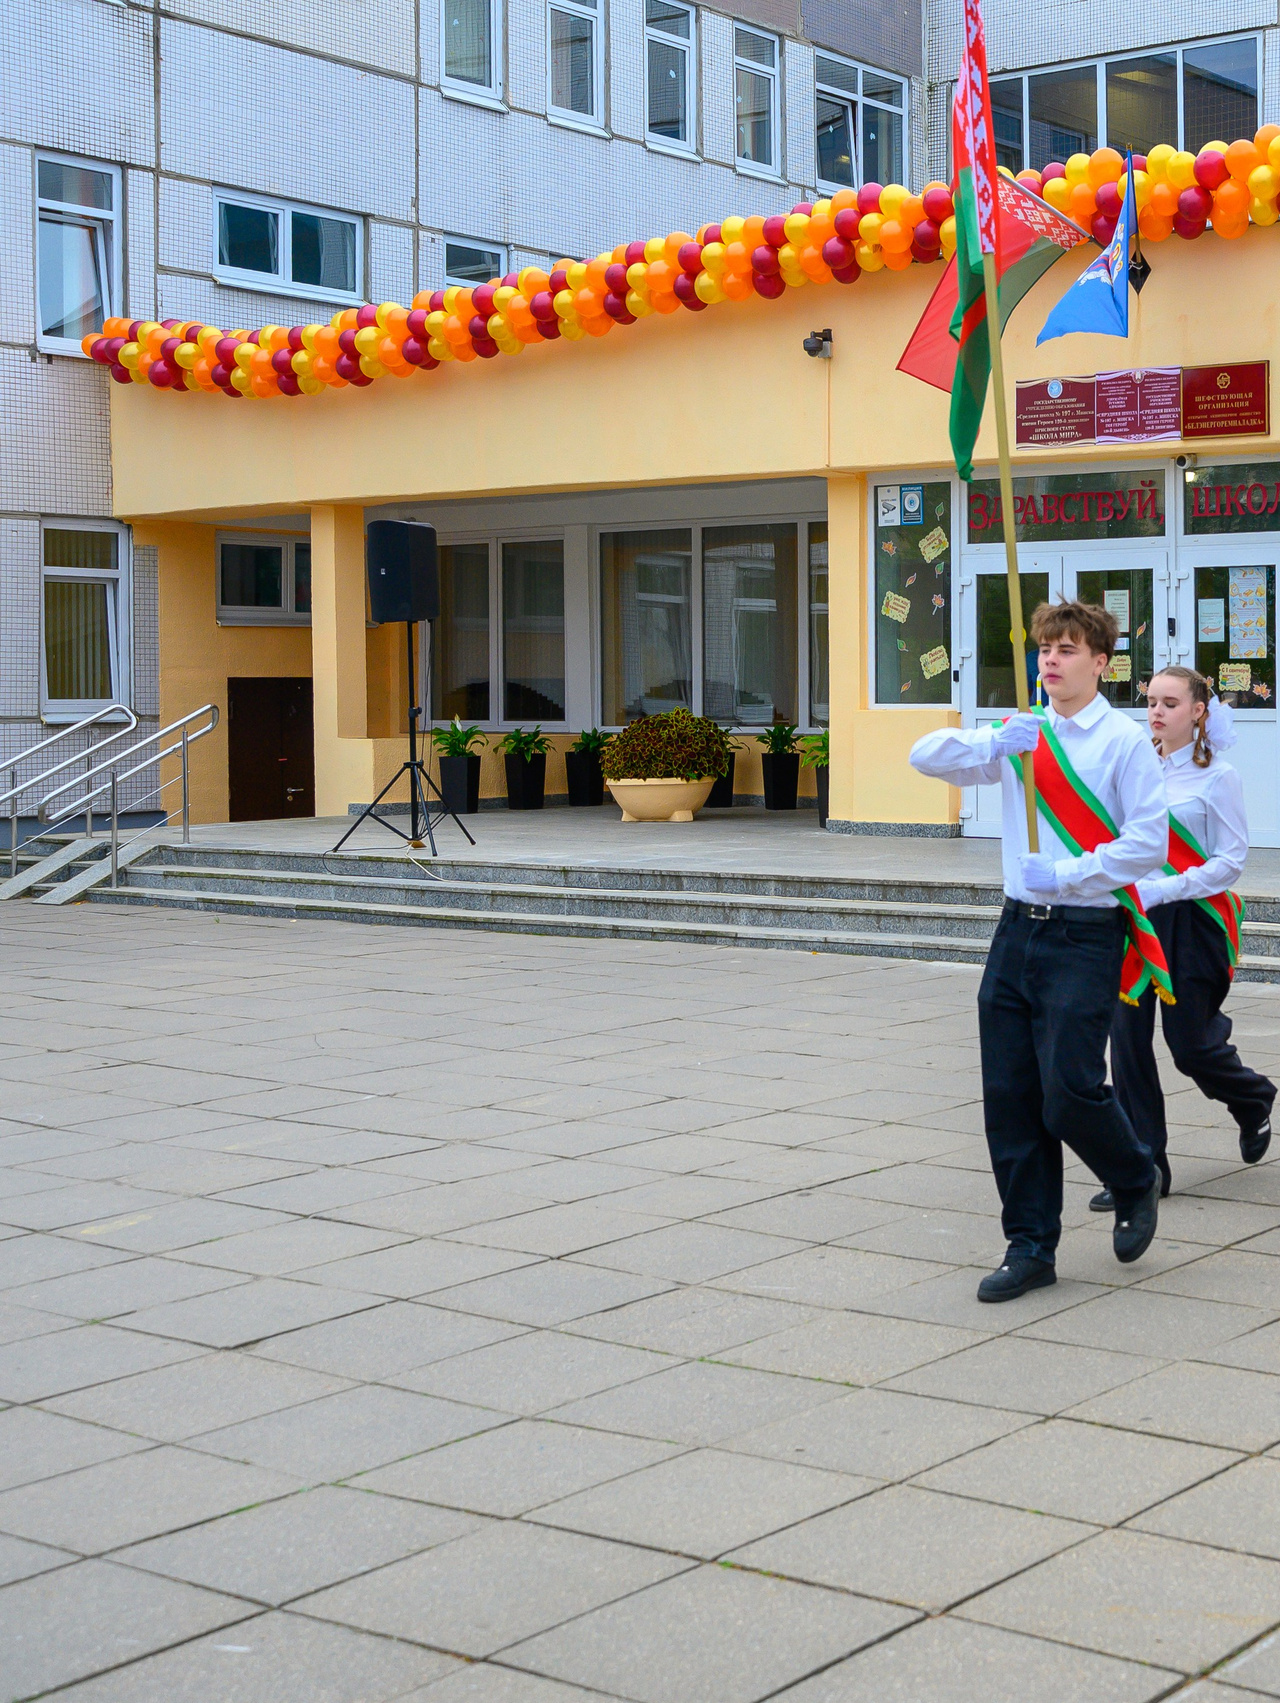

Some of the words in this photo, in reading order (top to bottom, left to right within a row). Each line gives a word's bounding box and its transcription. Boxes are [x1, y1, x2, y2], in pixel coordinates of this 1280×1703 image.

[1195, 392, 1253, 402] ШЕФСТВУЮЩАЯ
[1198, 401, 1249, 410] ОРГАНИЗАЦИЯ
[1185, 419, 1264, 429] «БЕЛЭНЕРГОРЕМНАЛАДКА»
[969, 480, 1164, 530] ЗДРАВСТВУЙ,
